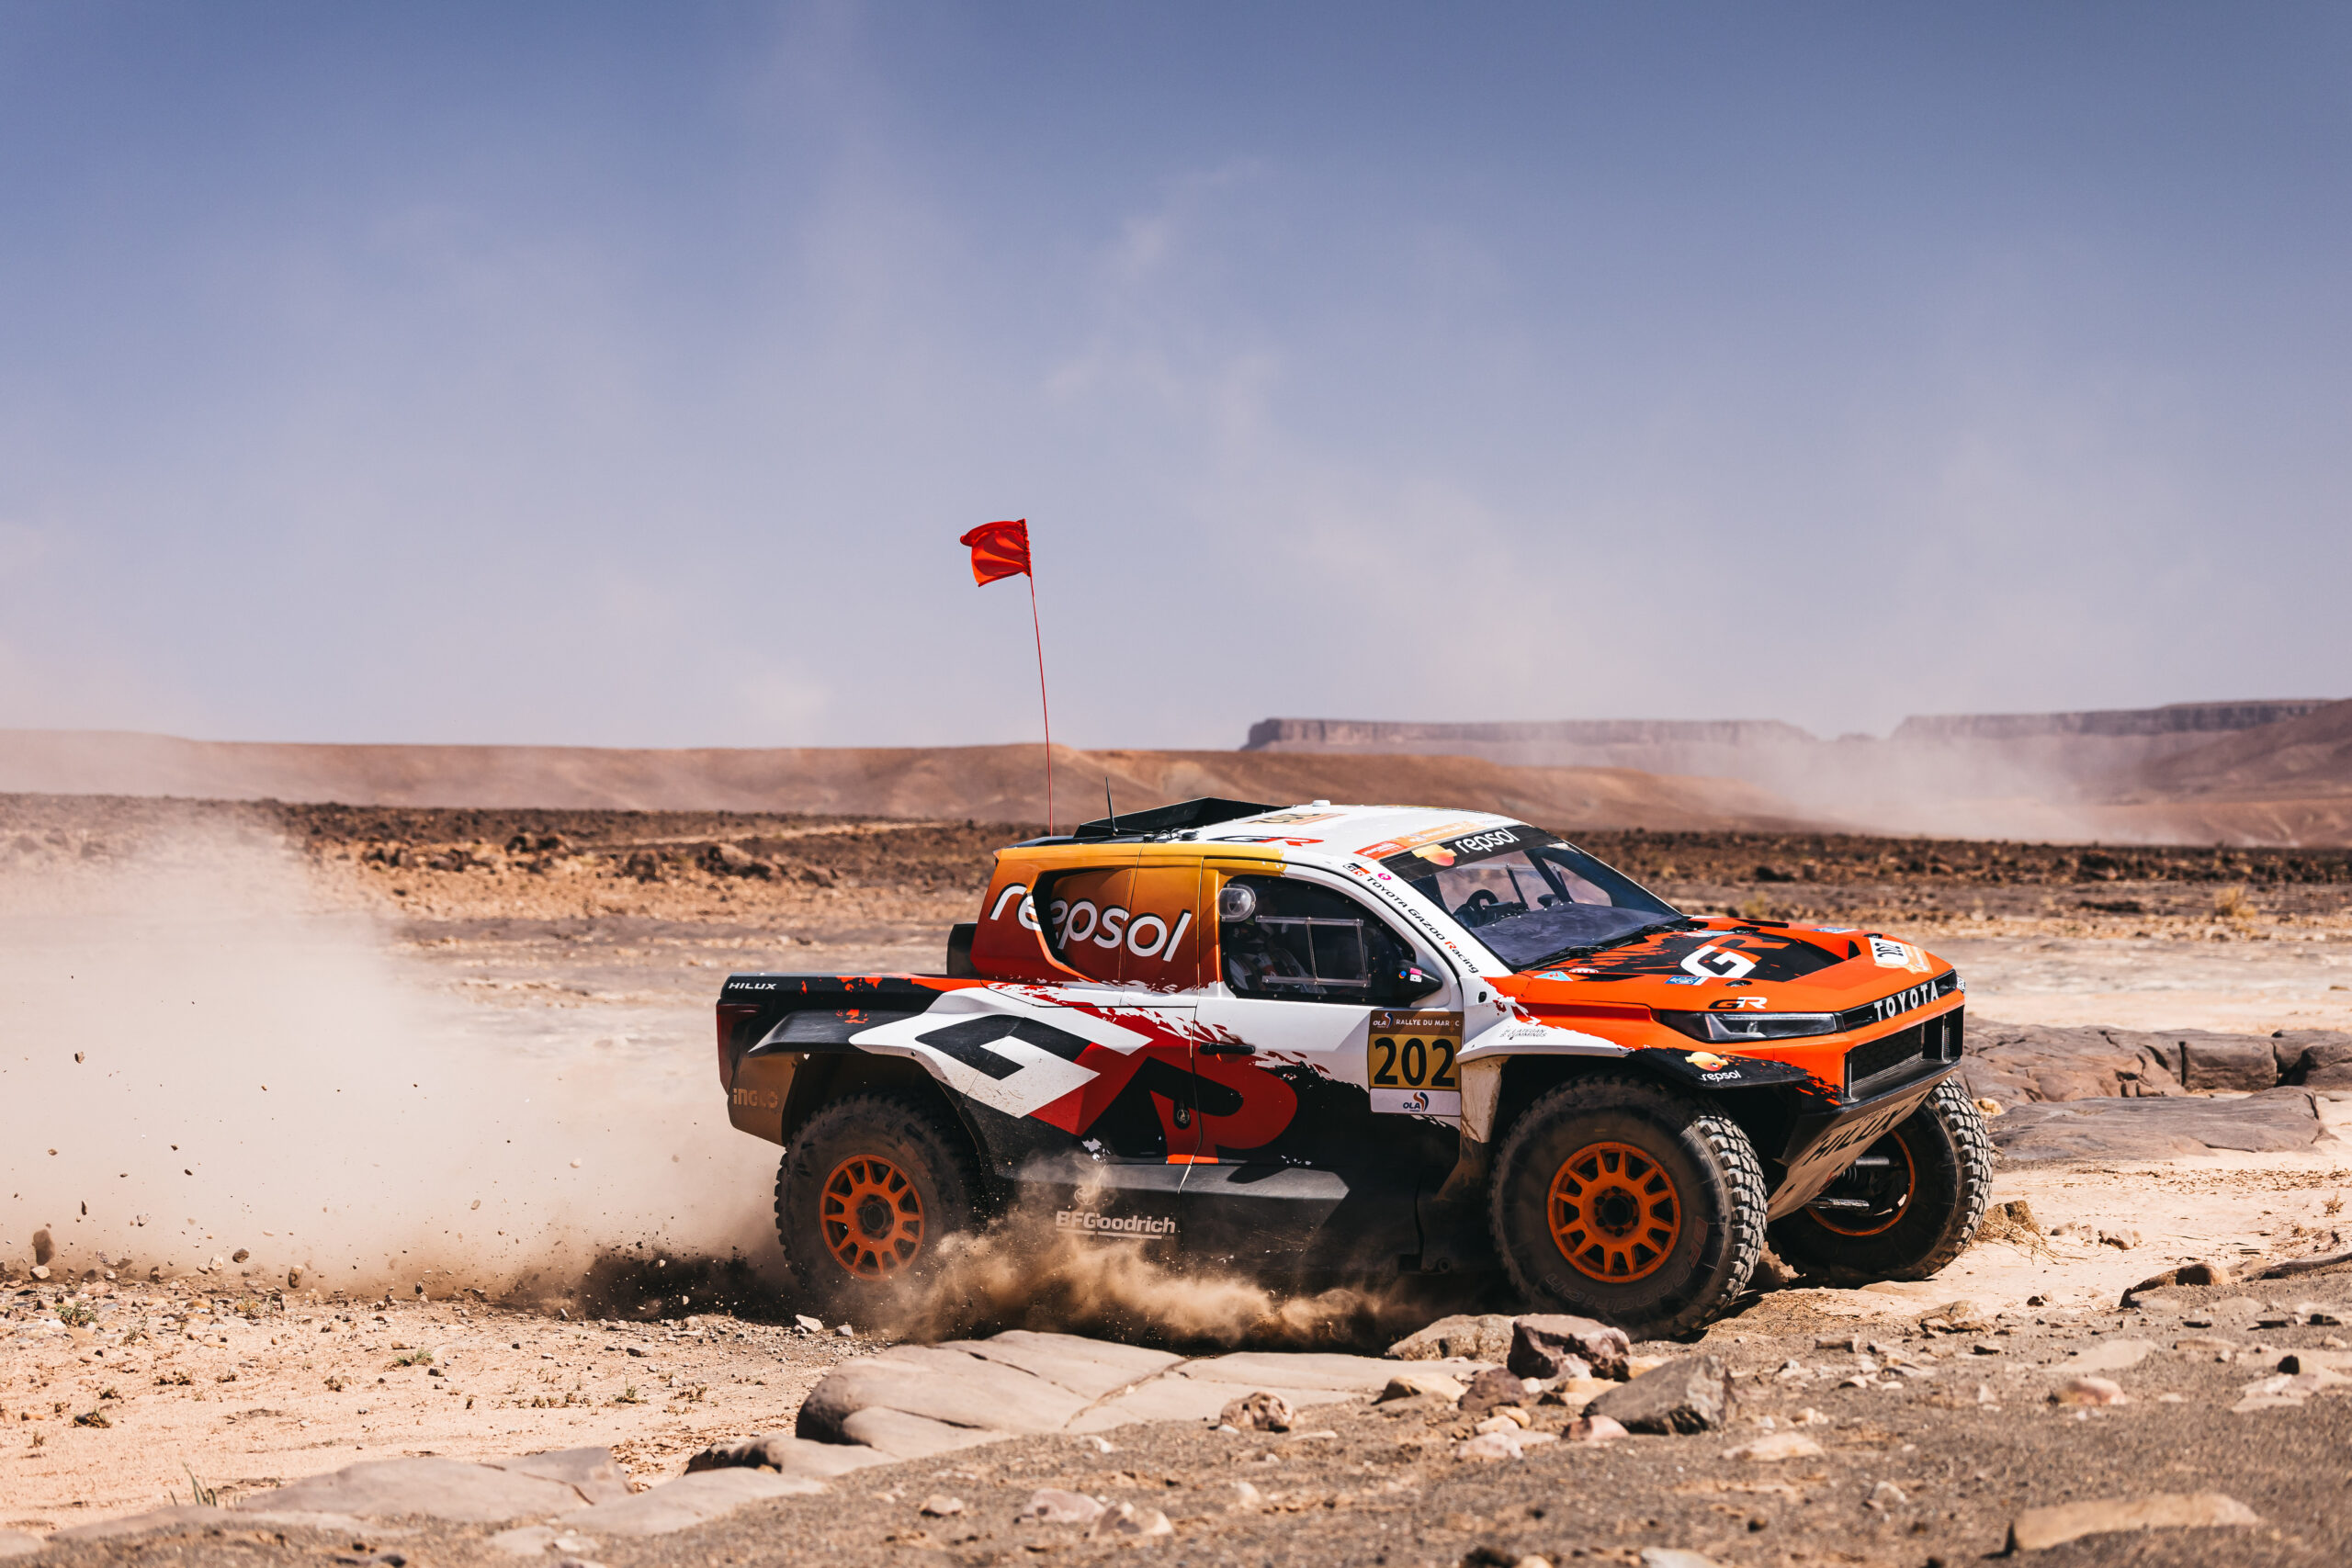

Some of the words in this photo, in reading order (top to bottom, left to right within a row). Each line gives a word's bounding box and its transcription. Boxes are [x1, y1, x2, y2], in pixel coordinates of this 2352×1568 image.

[1206, 835, 1325, 847] GR
[1454, 829, 1521, 853] repsol
[989, 883, 1193, 963] repsol
[1342, 863, 1371, 876] GR
[1367, 876, 1408, 908] TOYOTA
[1408, 908, 1446, 941] GAZOO
[1444, 941, 1479, 974] Racing
[1680, 934, 1791, 979] GR
[728, 982, 778, 990] HILUX
[1708, 996, 1768, 1010] GR
[1873, 980, 1939, 1022] TOYOTA
[1374, 1036, 1456, 1088] 202
[1701, 1069, 1742, 1083] repsol
[1402, 1101, 1421, 1110] OLA
[1801, 1104, 1910, 1168] HILUX
[1056, 1210, 1176, 1234] BFGoodrich
